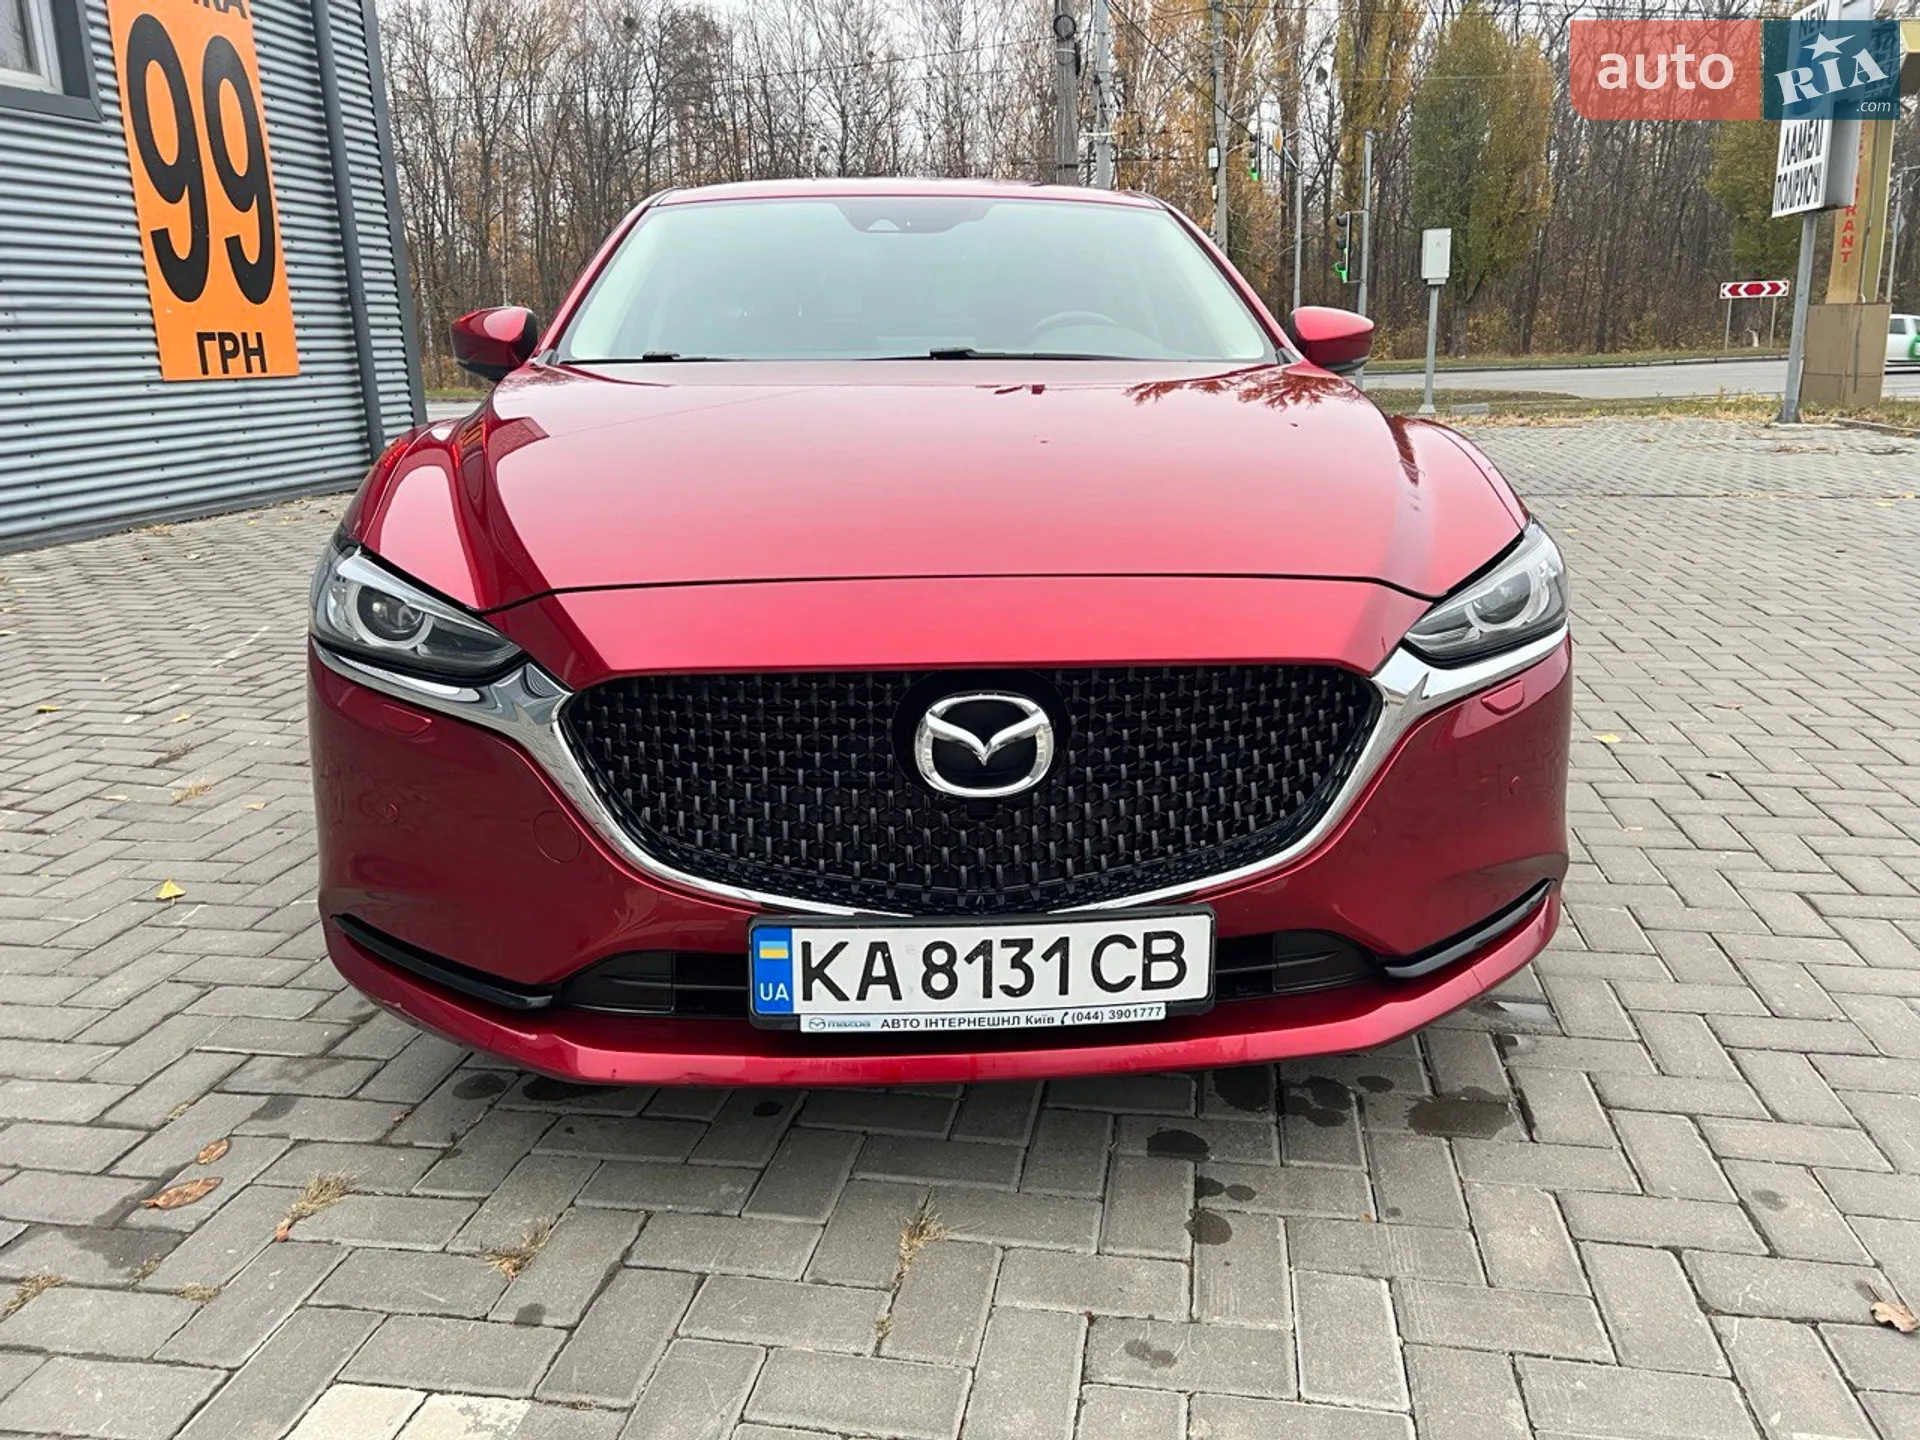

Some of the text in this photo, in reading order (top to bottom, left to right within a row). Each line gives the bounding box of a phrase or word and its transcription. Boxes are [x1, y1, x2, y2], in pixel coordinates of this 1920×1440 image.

[126, 13, 276, 305] 99
[196, 331, 268, 376] ГРН
[801, 930, 1188, 1002] KA 8131 CB
[759, 983, 790, 1002] UA
[880, 1005, 1163, 1030] АВТО ІНТЕРНЕШНЛ Київ (044) 3901777
